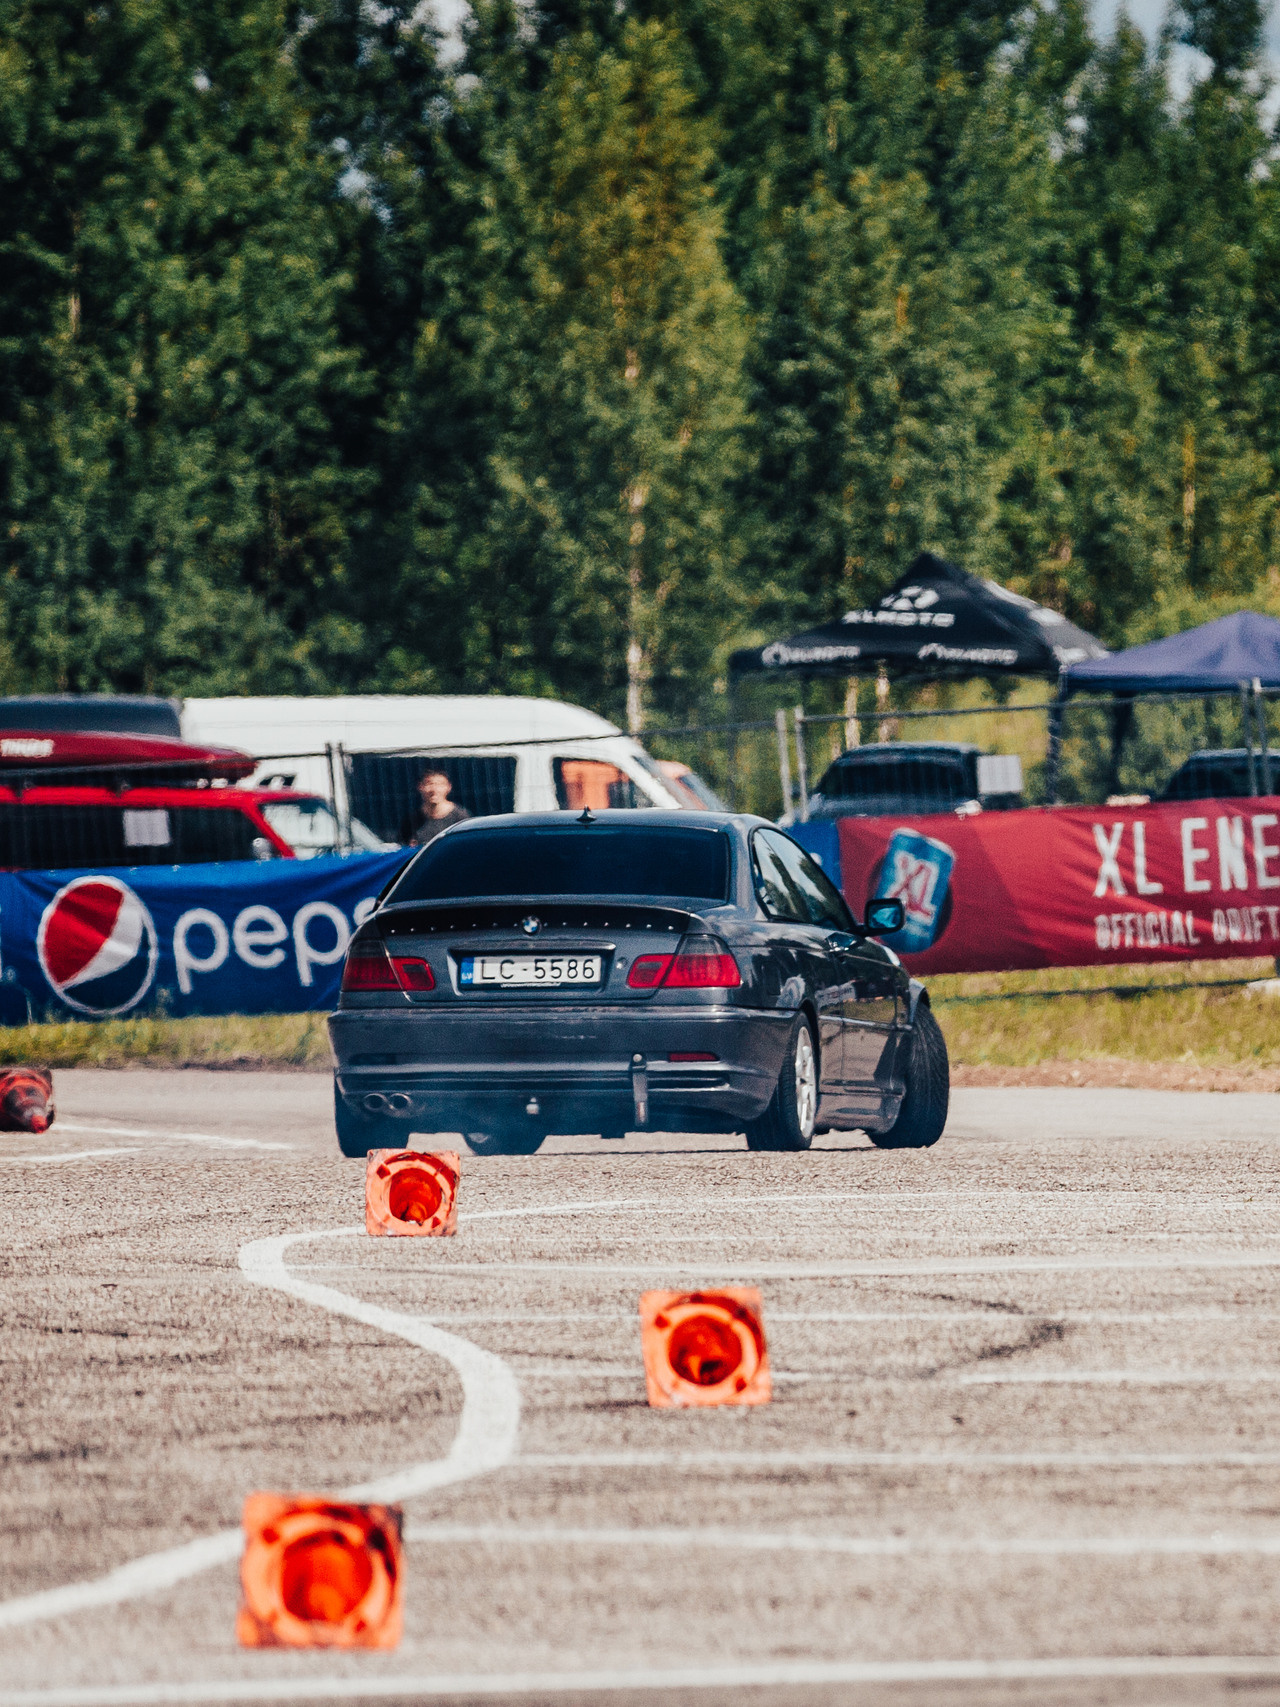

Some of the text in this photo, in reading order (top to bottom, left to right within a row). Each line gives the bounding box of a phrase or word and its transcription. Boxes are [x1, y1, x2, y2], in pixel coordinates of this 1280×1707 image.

[887, 852, 938, 920] XL
[1093, 820, 1164, 898] XL
[1095, 910, 1200, 949] OFFICIAL
[1212, 905, 1280, 945] DRIFT
